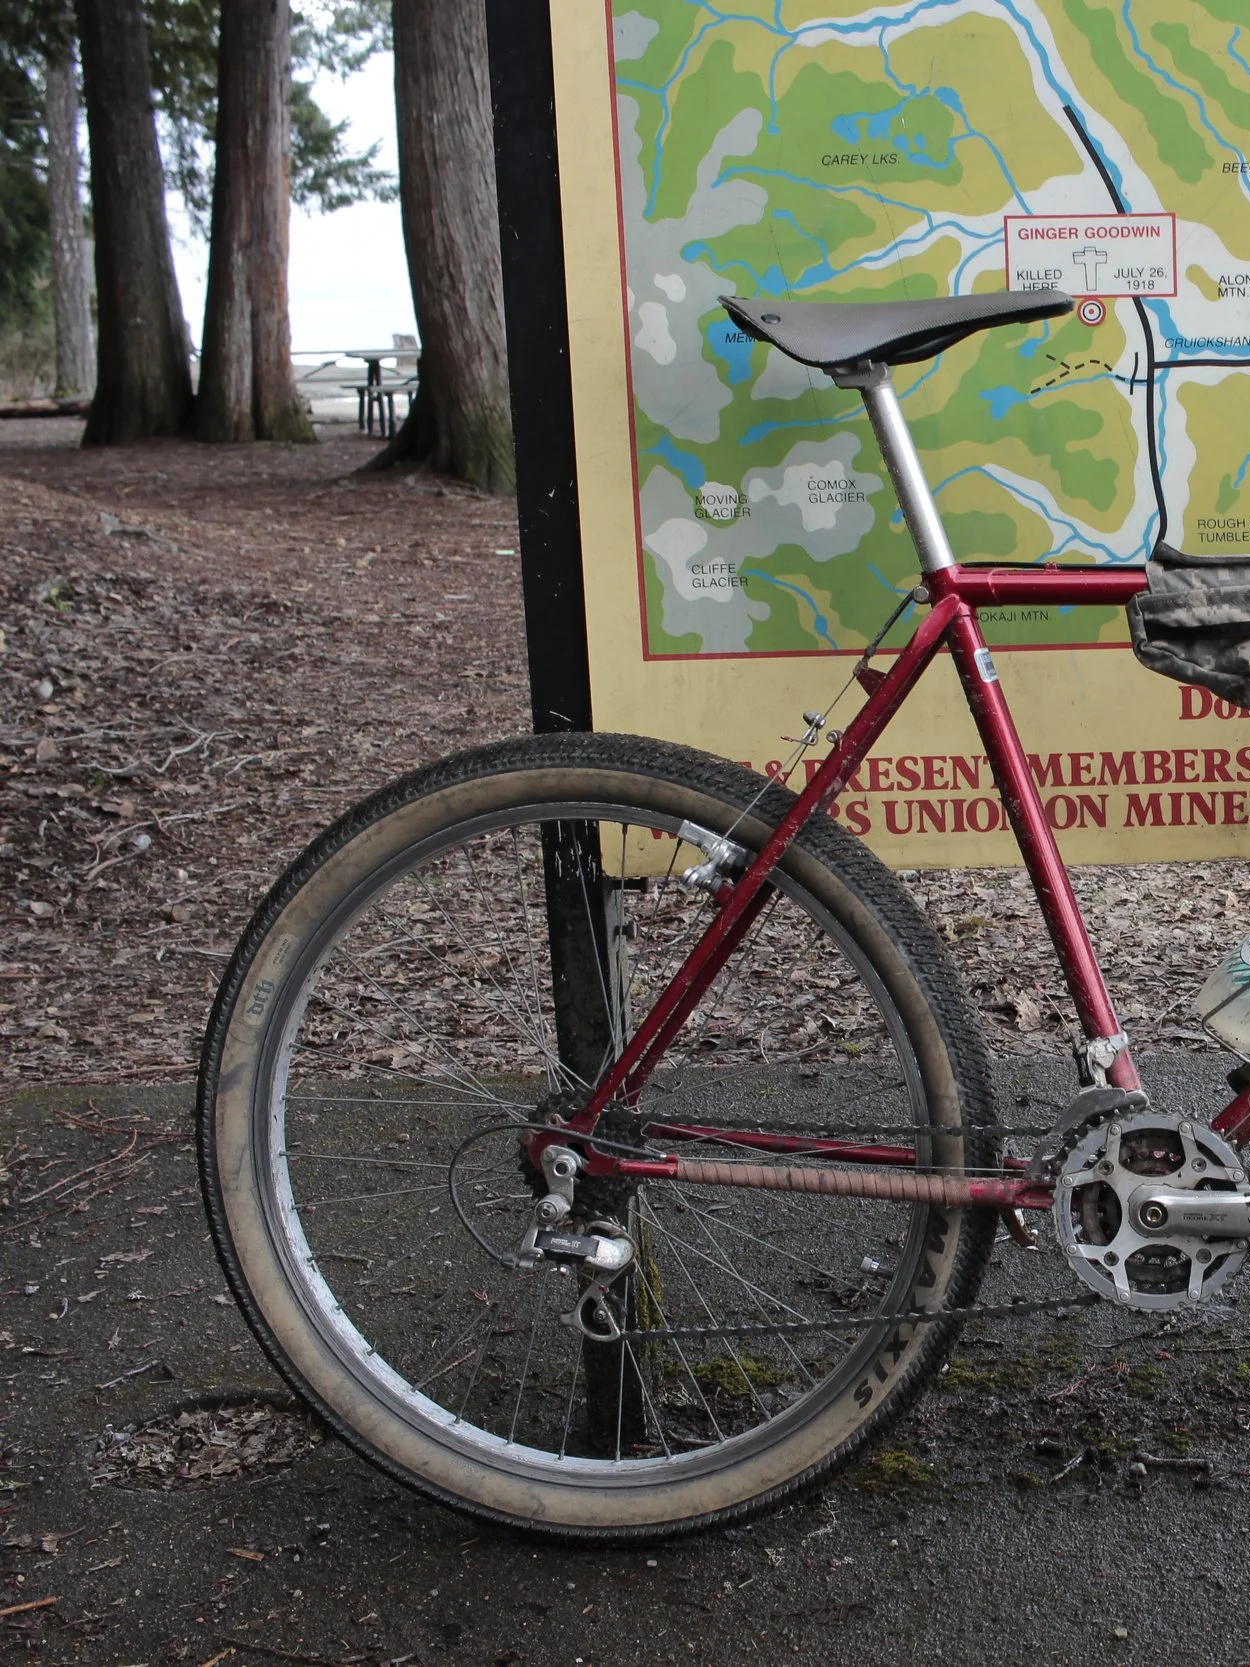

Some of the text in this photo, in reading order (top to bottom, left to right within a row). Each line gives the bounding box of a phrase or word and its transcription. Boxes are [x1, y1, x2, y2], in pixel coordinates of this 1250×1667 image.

[821, 153, 900, 166] CAREY LKS.
[1018, 226, 1161, 240] GINGER GOODWIN
[1016, 269, 1063, 280] KILLED
[1114, 267, 1145, 279] JULY
[1127, 280, 1155, 290] 1918
[807, 480, 857, 491] COMOX
[695, 494, 748, 505] MOVING
[809, 492, 865, 503] GLACIER
[695, 507, 750, 518] GLACIER
[1198, 519, 1246, 529] ROUGH
[1199, 532, 1249, 543] TUMBLE
[692, 563, 736, 575] CLIFFE
[692, 576, 749, 588] GLACIER
[1045, 794, 1109, 830] ON
